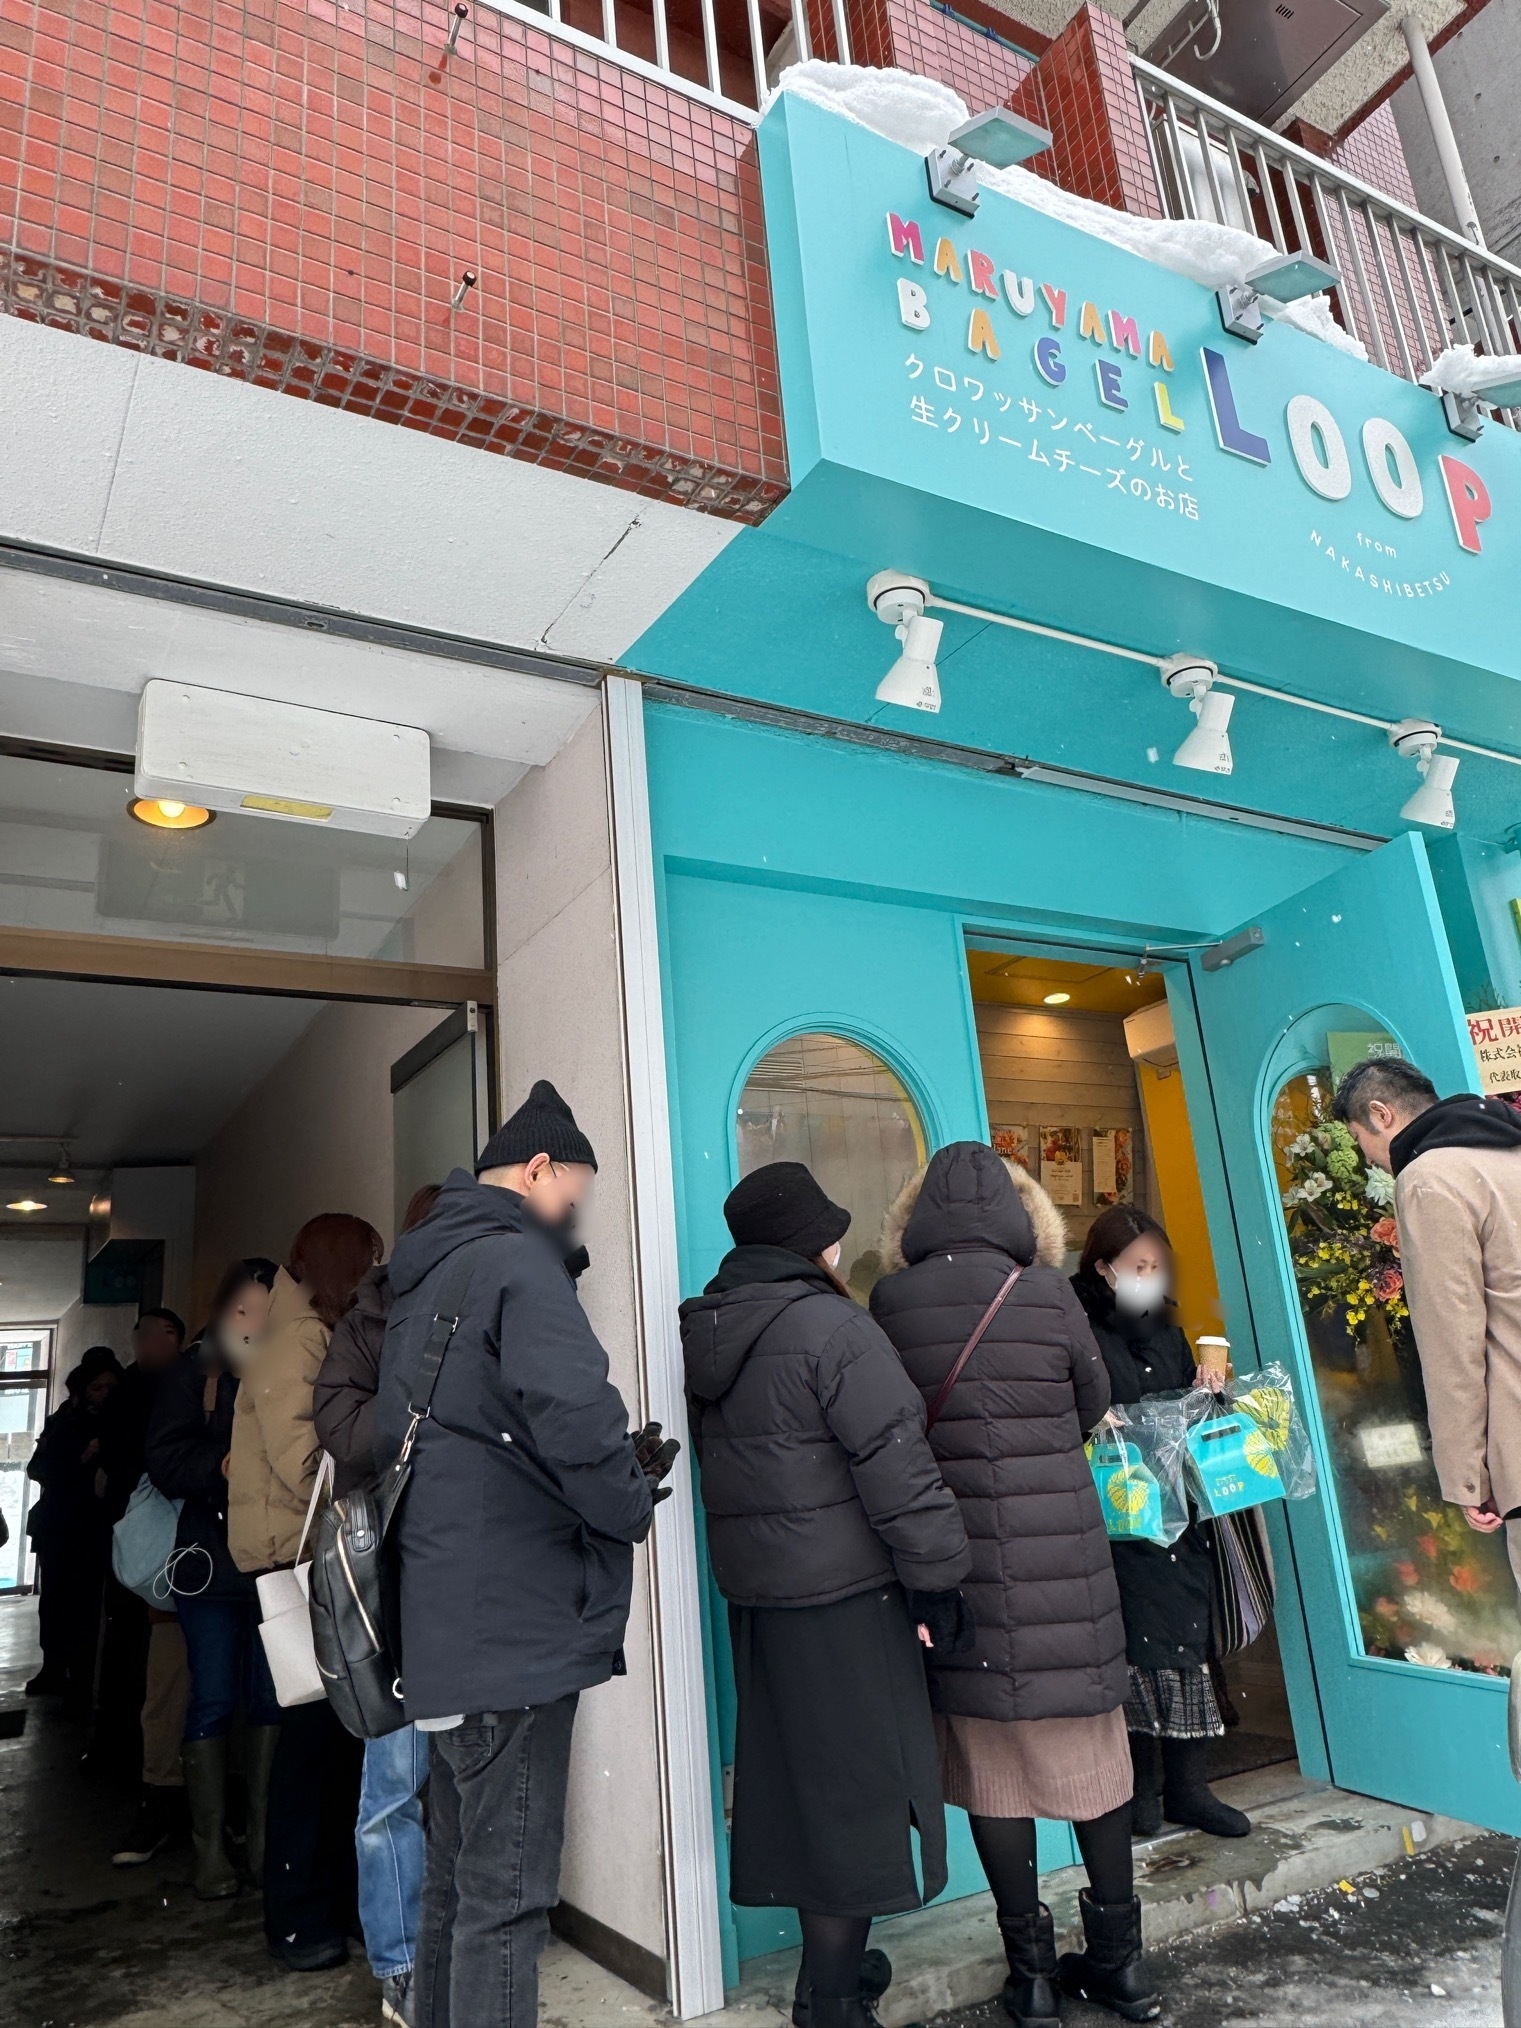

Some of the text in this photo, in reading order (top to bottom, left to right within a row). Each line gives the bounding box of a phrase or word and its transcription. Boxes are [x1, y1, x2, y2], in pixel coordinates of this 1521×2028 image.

[886, 211, 1174, 372] MARUYAMA
[897, 277, 1184, 431] BAGEL
[904, 353, 1193, 482] クロワッサンベーグルと
[910, 395, 1199, 520] 生クリームチーズのお店
[1200, 346, 1492, 554] LOOP
[1310, 530, 1451, 598] NAKASHIBETSU
[1356, 532, 1397, 558] from
